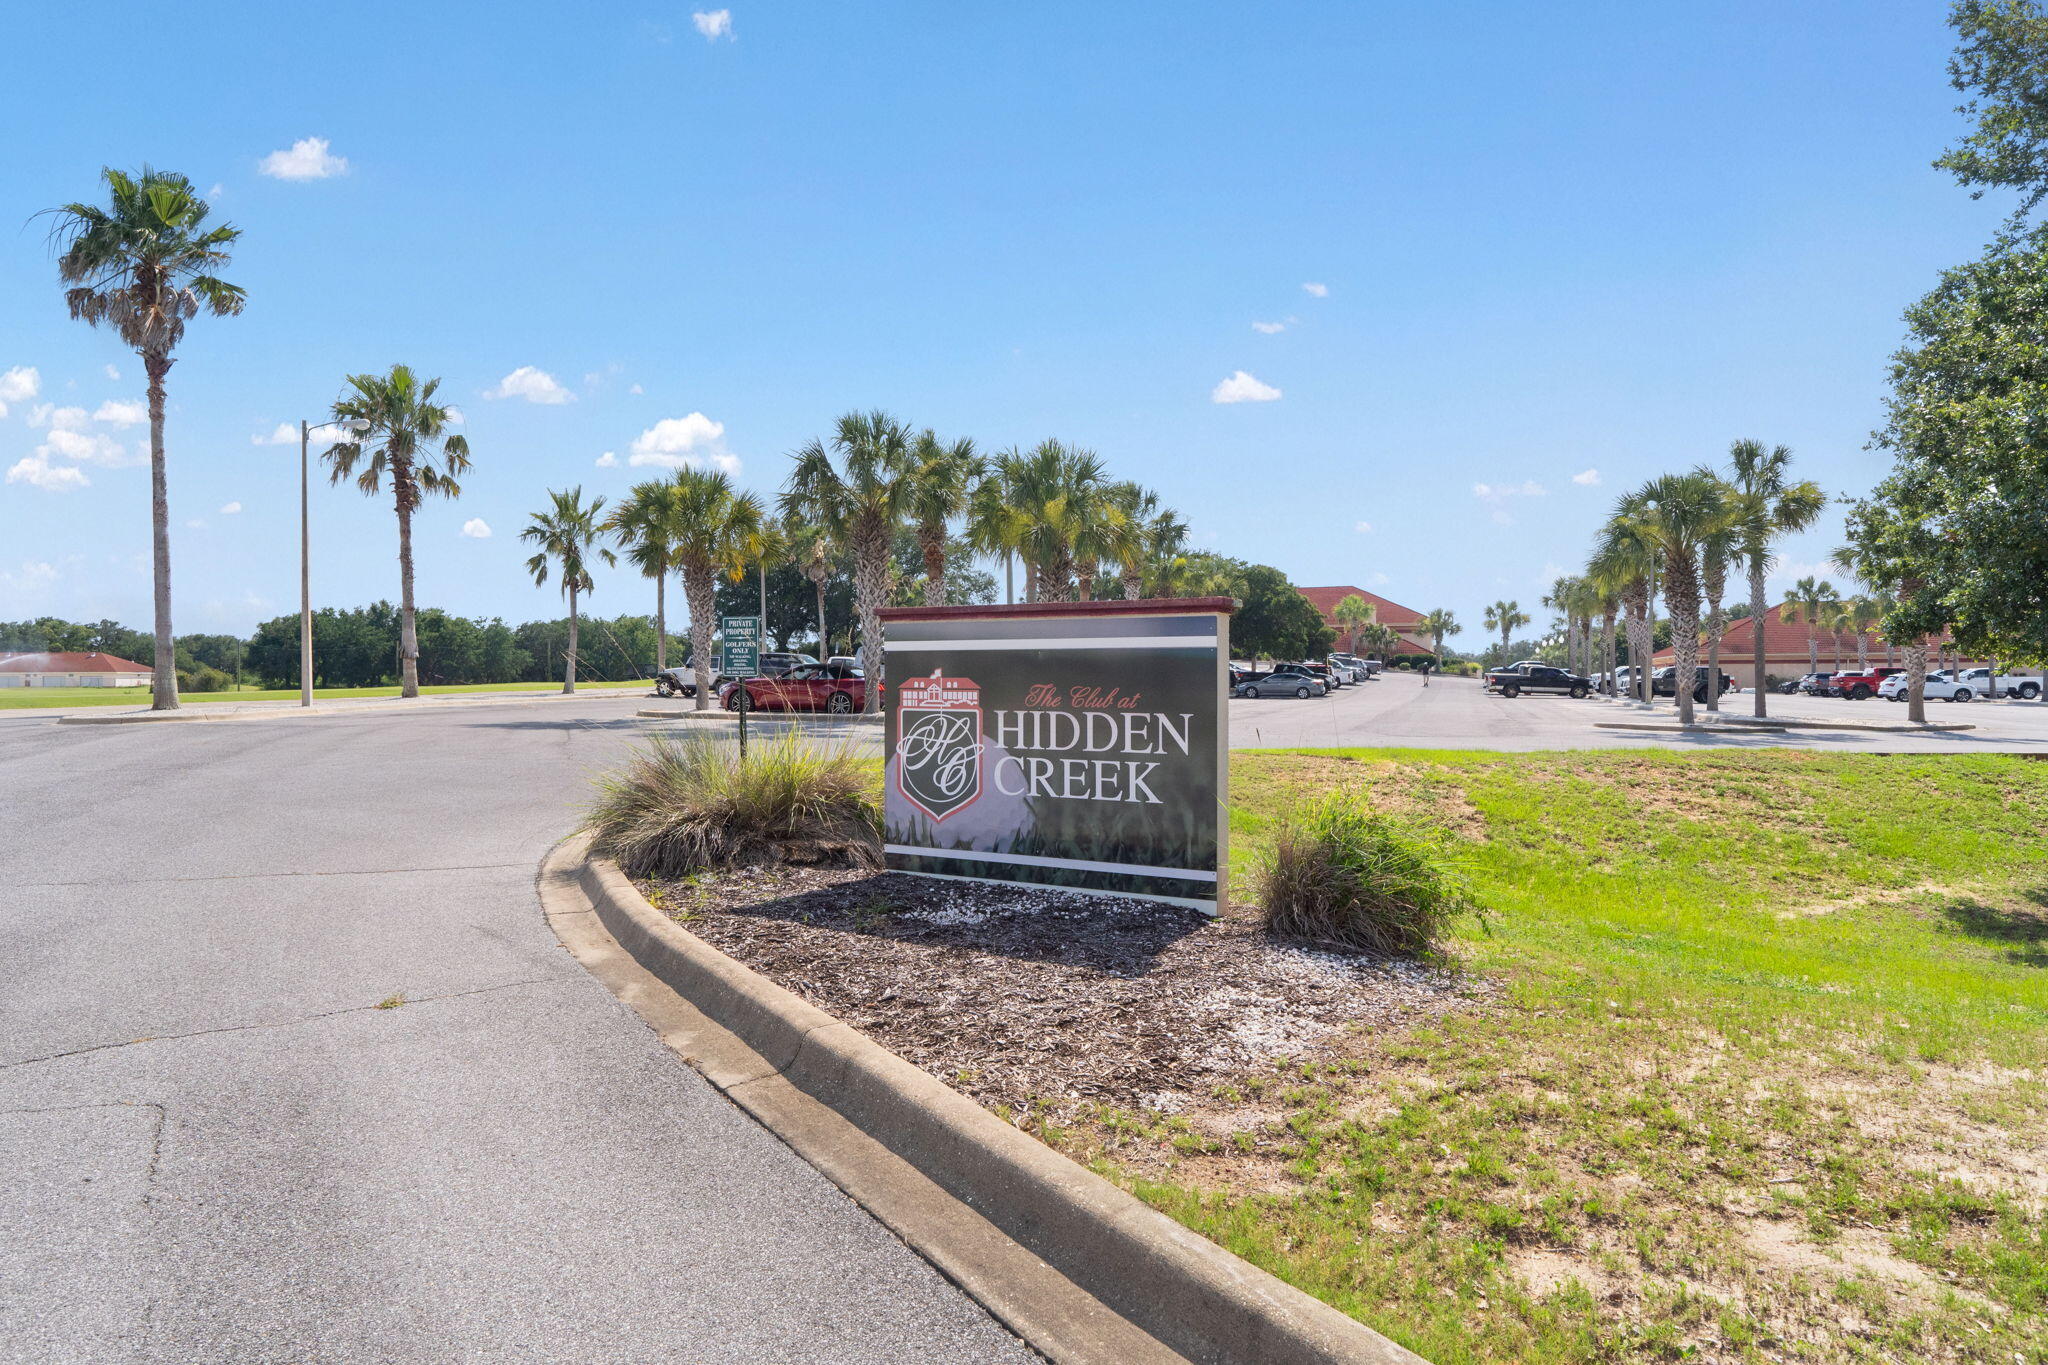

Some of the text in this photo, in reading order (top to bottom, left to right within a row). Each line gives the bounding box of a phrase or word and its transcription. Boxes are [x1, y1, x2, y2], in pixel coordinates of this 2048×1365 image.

[1025, 684, 1141, 709] The Club at
[993, 710, 1194, 756] HIDDEN
[993, 756, 1163, 804] CREEK
